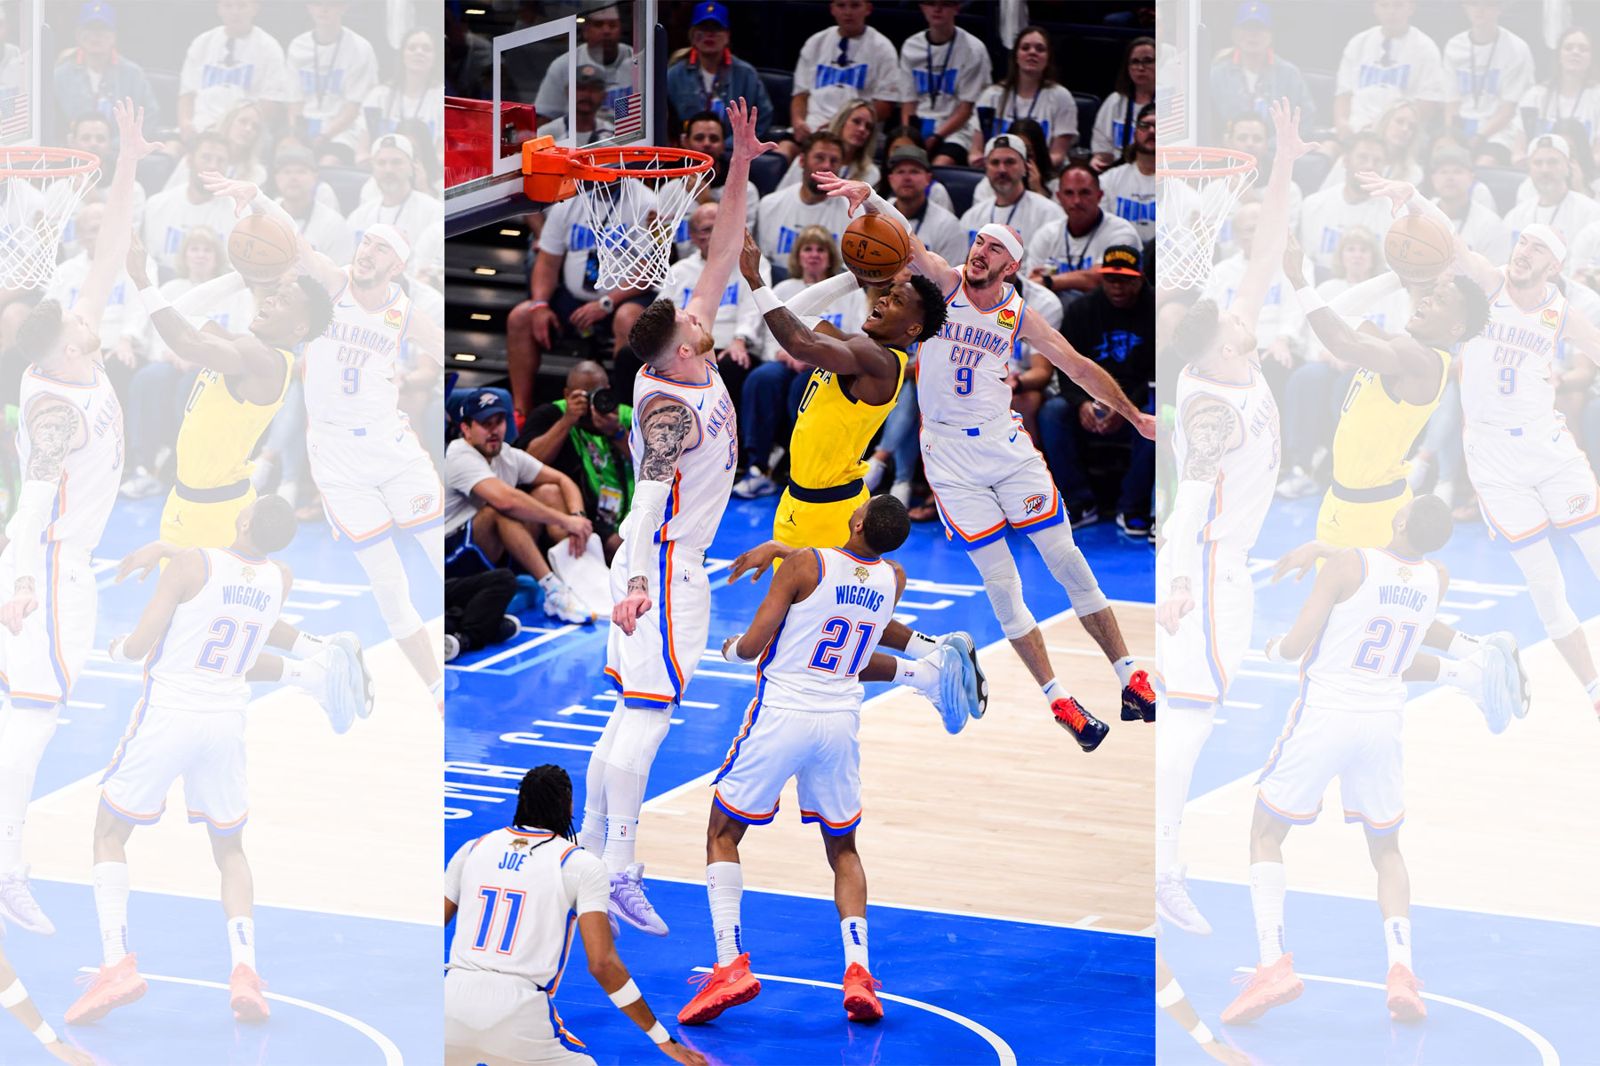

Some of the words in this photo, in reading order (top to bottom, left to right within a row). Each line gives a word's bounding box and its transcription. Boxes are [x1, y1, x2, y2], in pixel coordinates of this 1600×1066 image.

[949, 344, 985, 367] CITY
[342, 367, 362, 398] 9
[799, 379, 820, 414] 0
[955, 367, 975, 398] 9
[1498, 367, 1518, 398] 9
[222, 585, 271, 612] WIGGINS
[835, 585, 884, 612] WIGGINS
[1378, 585, 1427, 612] WIGGINS
[195, 616, 263, 677] 21
[808, 616, 876, 677] 21
[1351, 616, 1419, 677] 21
[498, 852, 527, 871] JOE
[471, 885, 527, 956] 11
